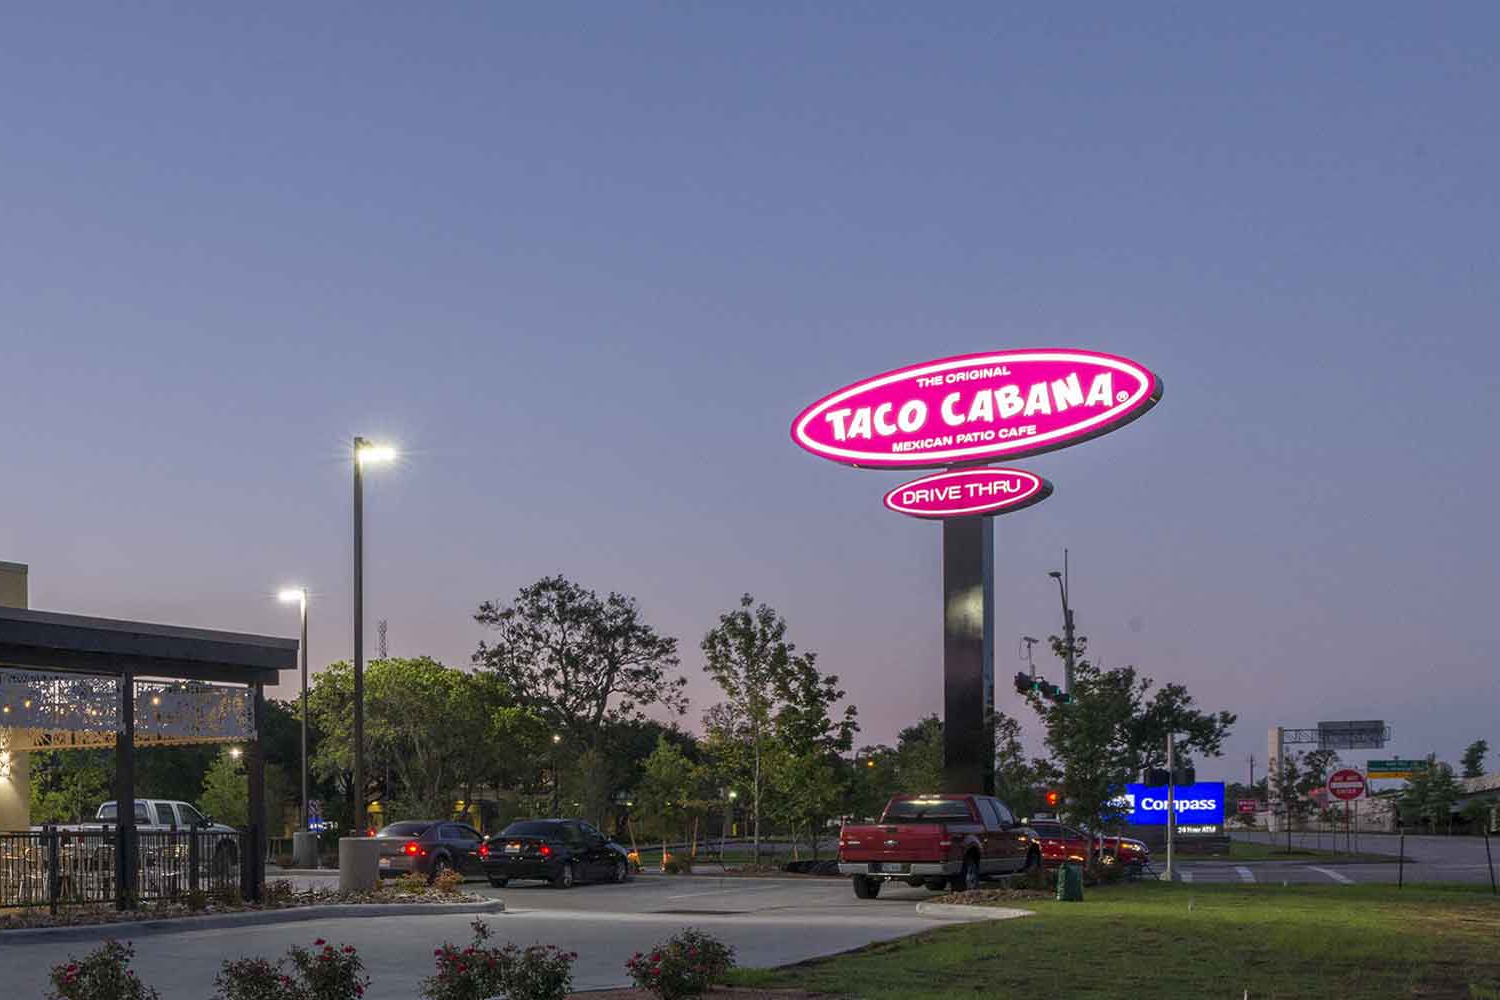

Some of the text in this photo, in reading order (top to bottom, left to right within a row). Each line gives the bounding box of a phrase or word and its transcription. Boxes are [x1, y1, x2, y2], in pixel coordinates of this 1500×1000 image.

[916, 366, 1011, 389] THE ORIGINAL
[825, 371, 1114, 442] TACO CABANA
[891, 424, 1037, 453] MEXICAN PATIO CAFE
[902, 479, 1022, 505] DRIVE THRU
